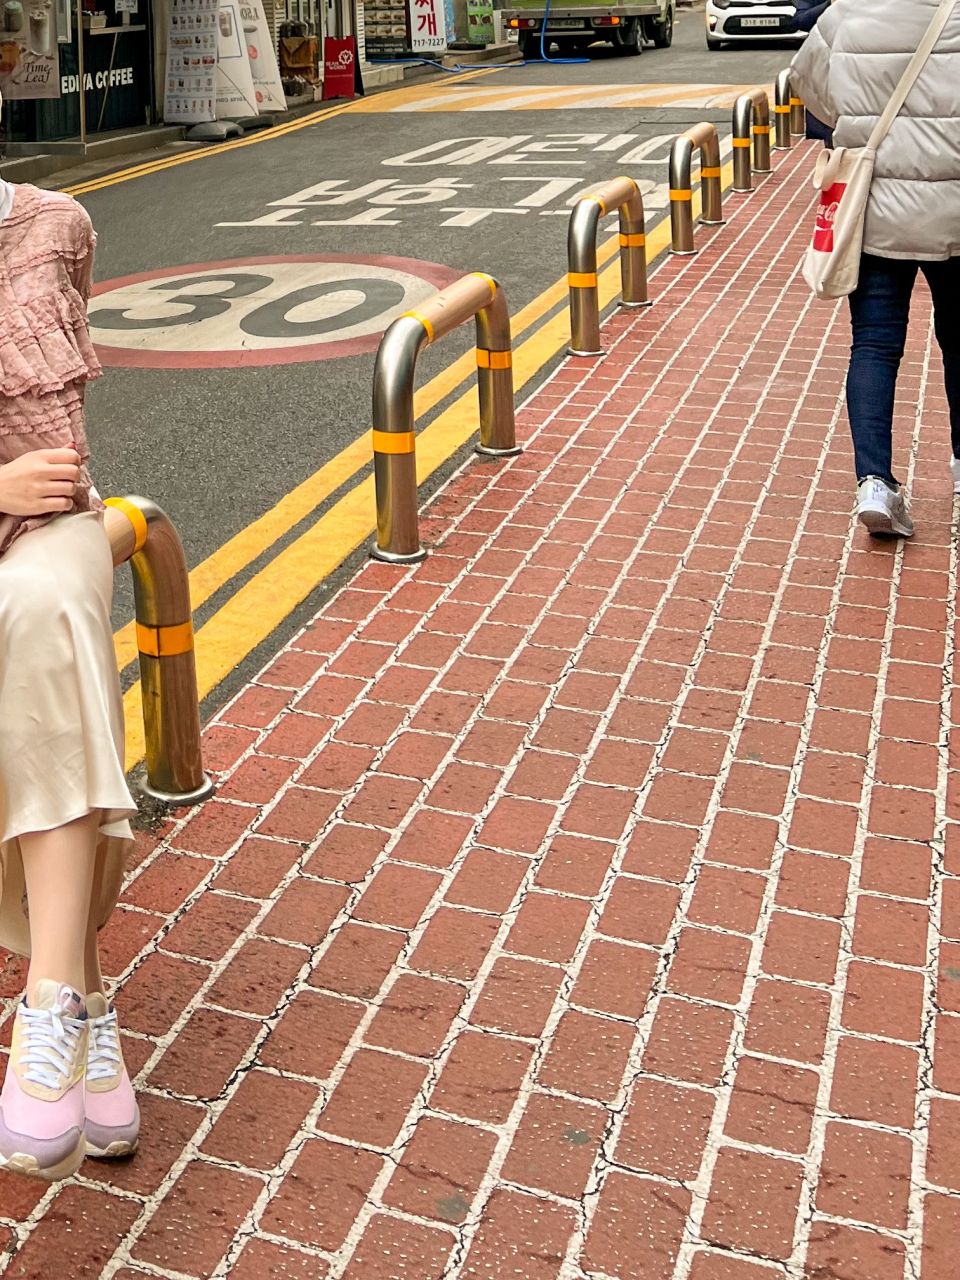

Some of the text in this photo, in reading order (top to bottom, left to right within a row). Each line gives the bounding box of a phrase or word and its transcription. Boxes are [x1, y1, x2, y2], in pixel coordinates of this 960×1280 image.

[413, 38, 445, 47] 717-7227
[24, 61, 49, 72] Time
[24, 67, 53, 83] Leaf
[95, 66, 133, 89] COFFEE
[381, 133, 734, 166] 어린이
[87, 272, 406, 338] 30
